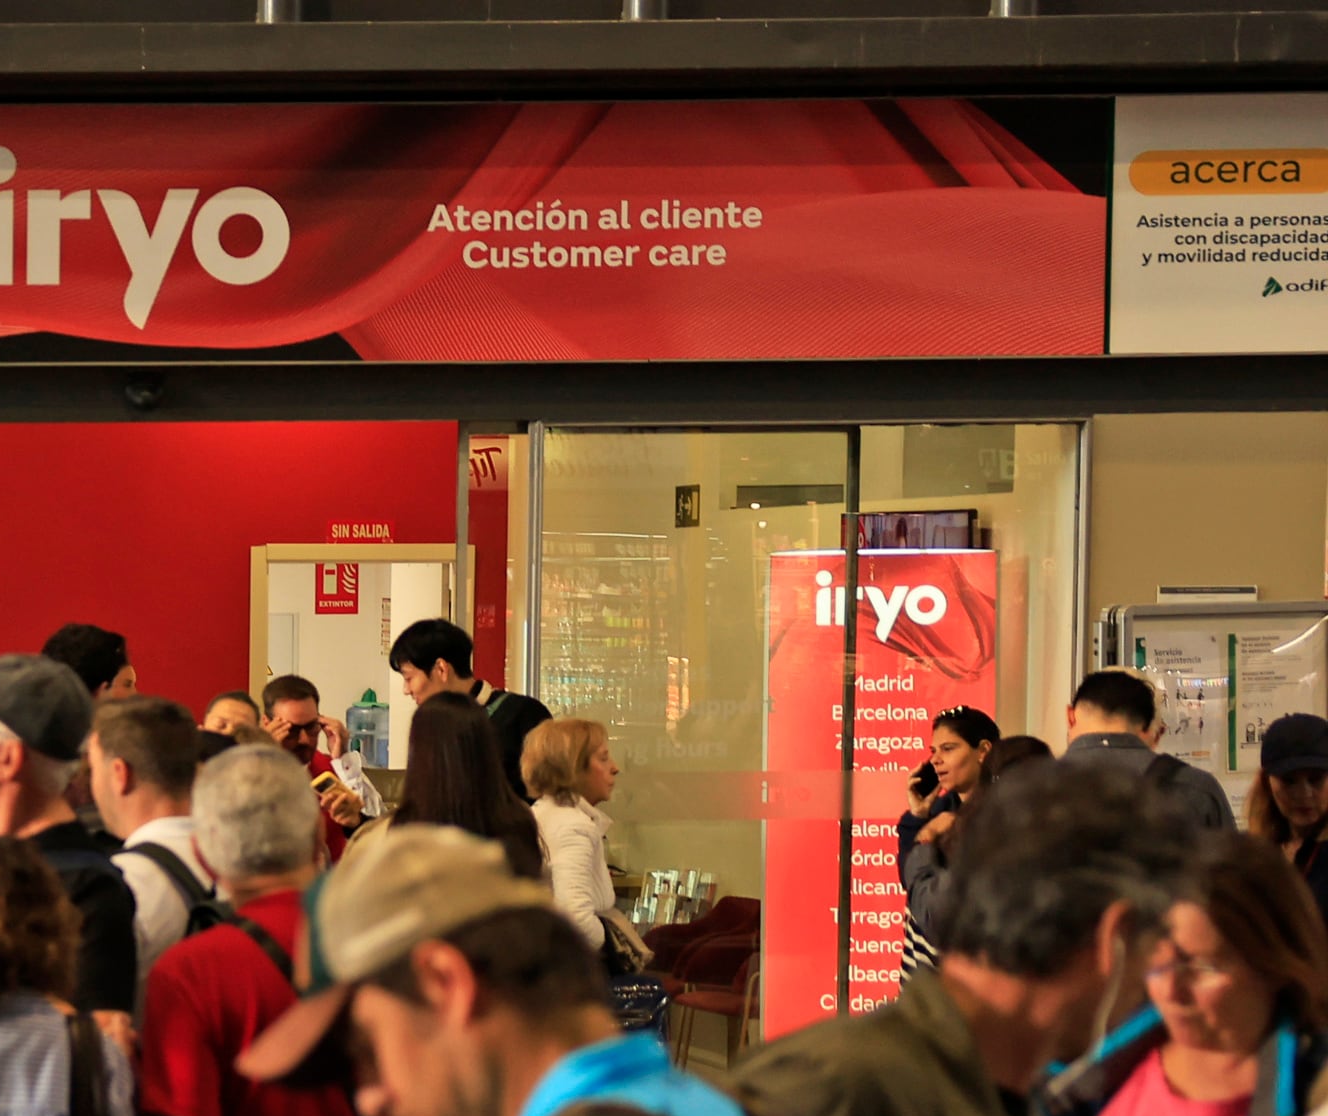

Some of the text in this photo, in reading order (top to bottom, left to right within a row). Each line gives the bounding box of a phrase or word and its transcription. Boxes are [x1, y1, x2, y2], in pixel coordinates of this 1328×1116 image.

[1169, 159, 1301, 184] acerca
[427, 199, 763, 232] Atención al cliente
[1136, 213, 1328, 230] Asistencia a personas
[1174, 234, 1207, 246] con
[462, 240, 728, 269] Customer care
[1141, 247, 1328, 266] y movilidad reducida
[331, 524, 390, 539] SIN SALIDA
[319, 600, 354, 608] EXTINTOR
